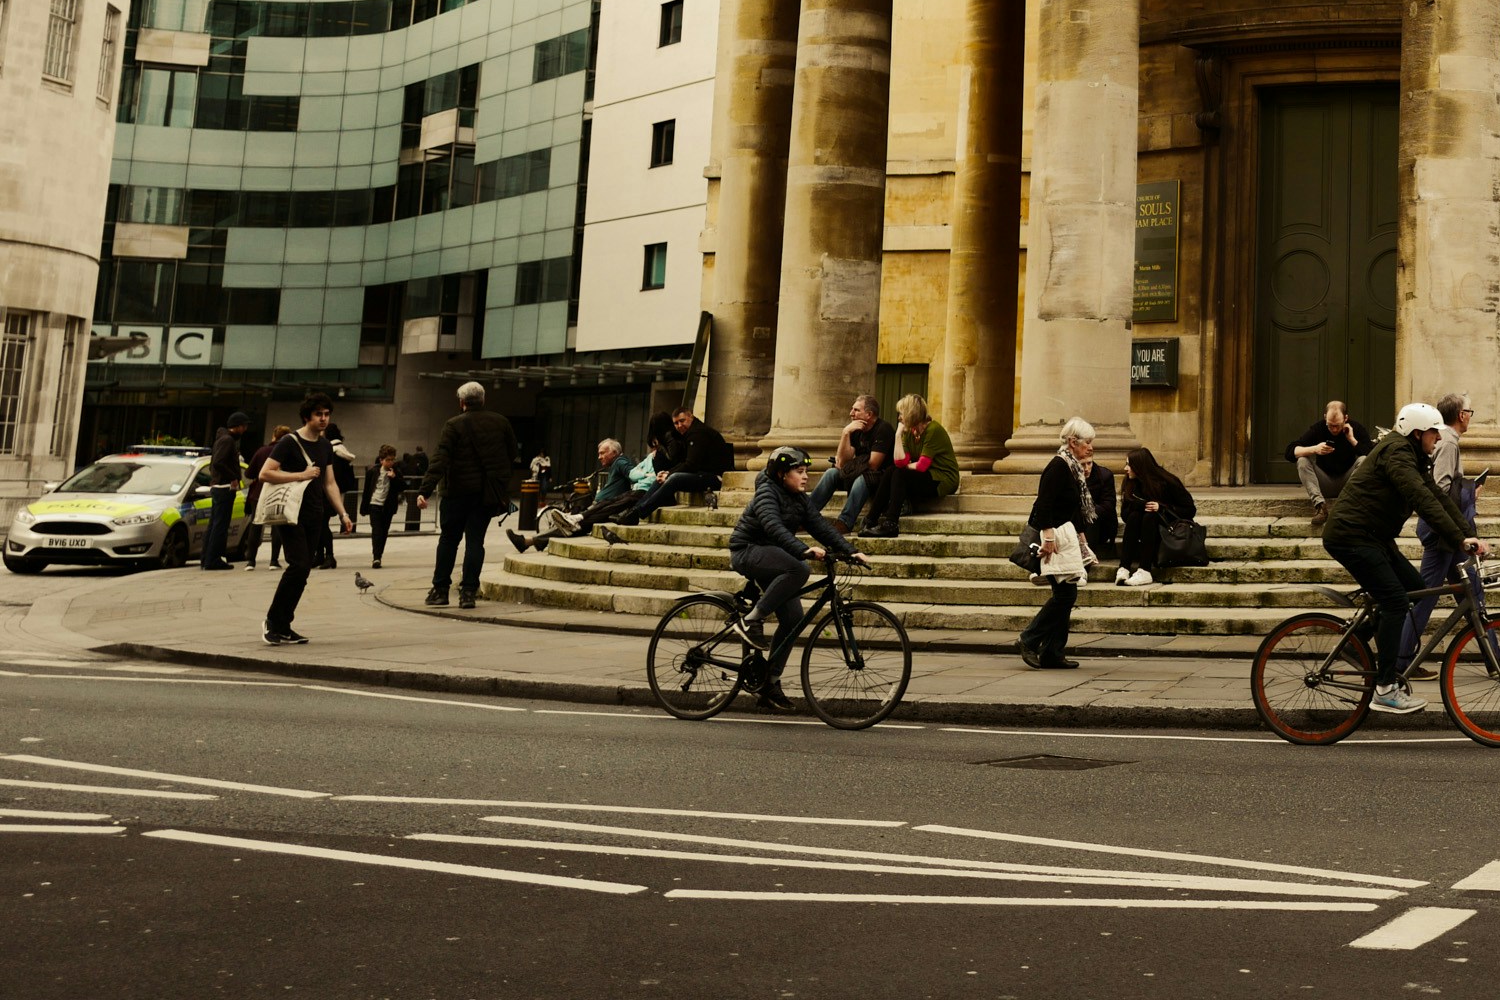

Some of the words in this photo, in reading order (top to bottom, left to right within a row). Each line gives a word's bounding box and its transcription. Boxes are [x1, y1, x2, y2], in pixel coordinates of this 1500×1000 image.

[1140, 202, 1171, 216] SOULS
[1151, 217, 1172, 226] PLACE
[91, 331, 204, 360] BC
[1137, 349, 1150, 362] YOU
[1151, 349, 1165, 361] ARE
[48, 538, 67, 546] BV16
